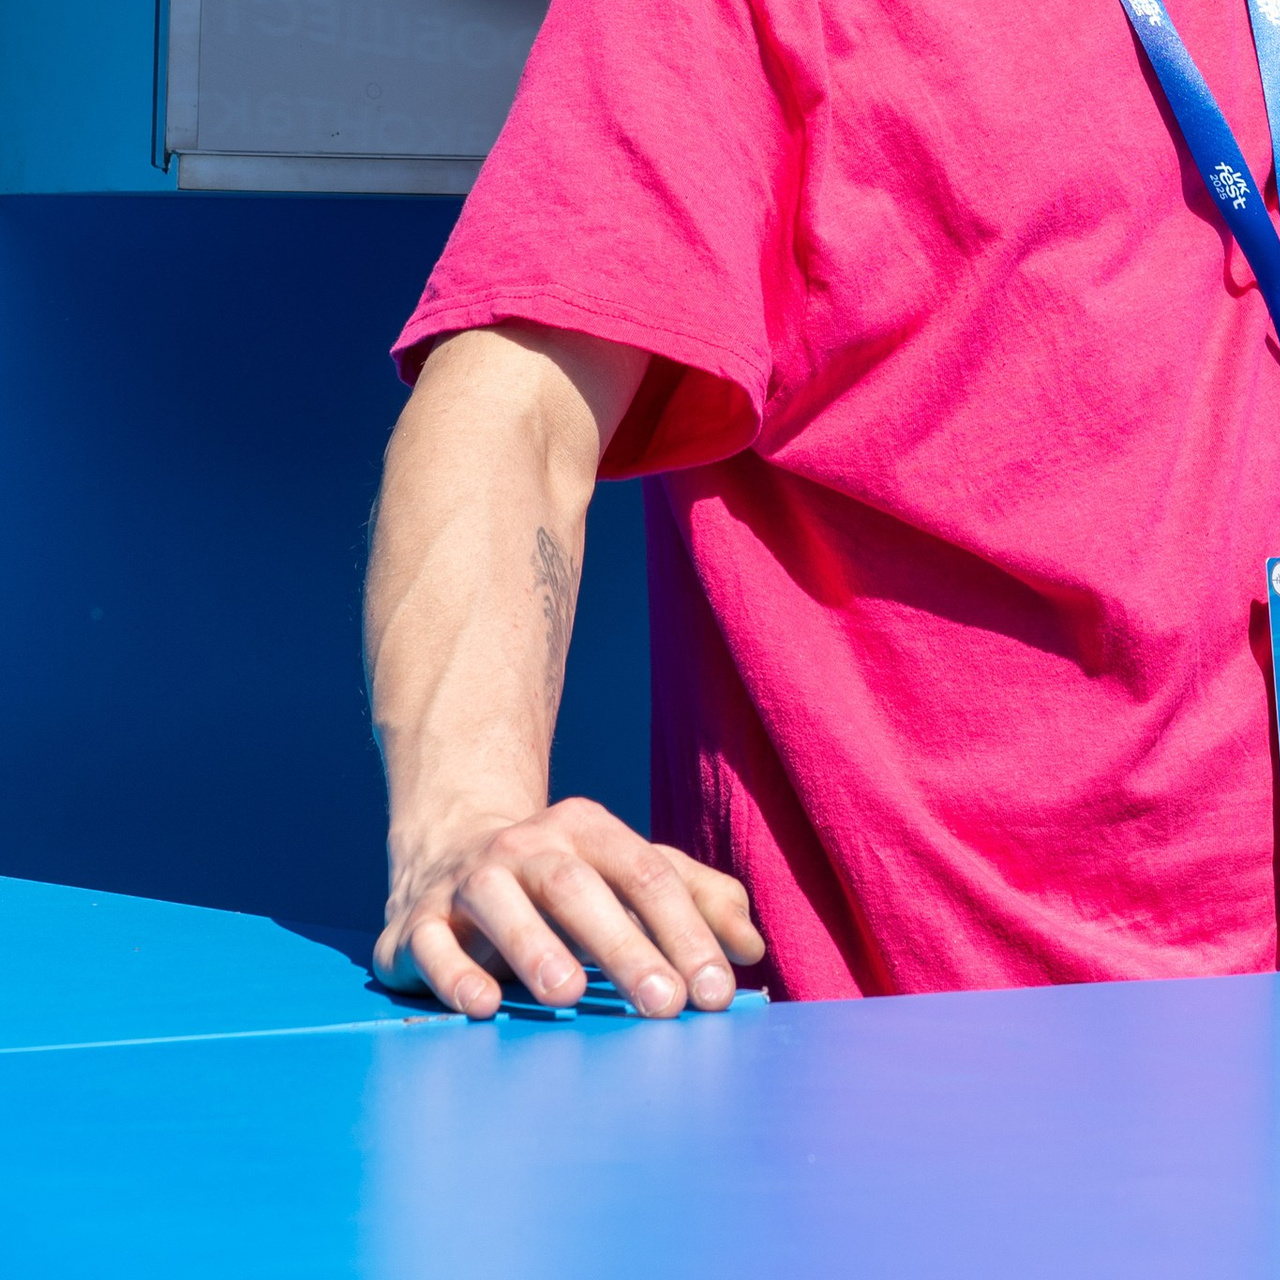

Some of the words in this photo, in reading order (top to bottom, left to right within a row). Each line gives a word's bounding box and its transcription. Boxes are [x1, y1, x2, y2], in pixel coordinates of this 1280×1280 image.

[1209, 173, 1228, 200] 2025
[1214, 161, 1246, 209] fest
[1232, 172, 1250, 195] VK
